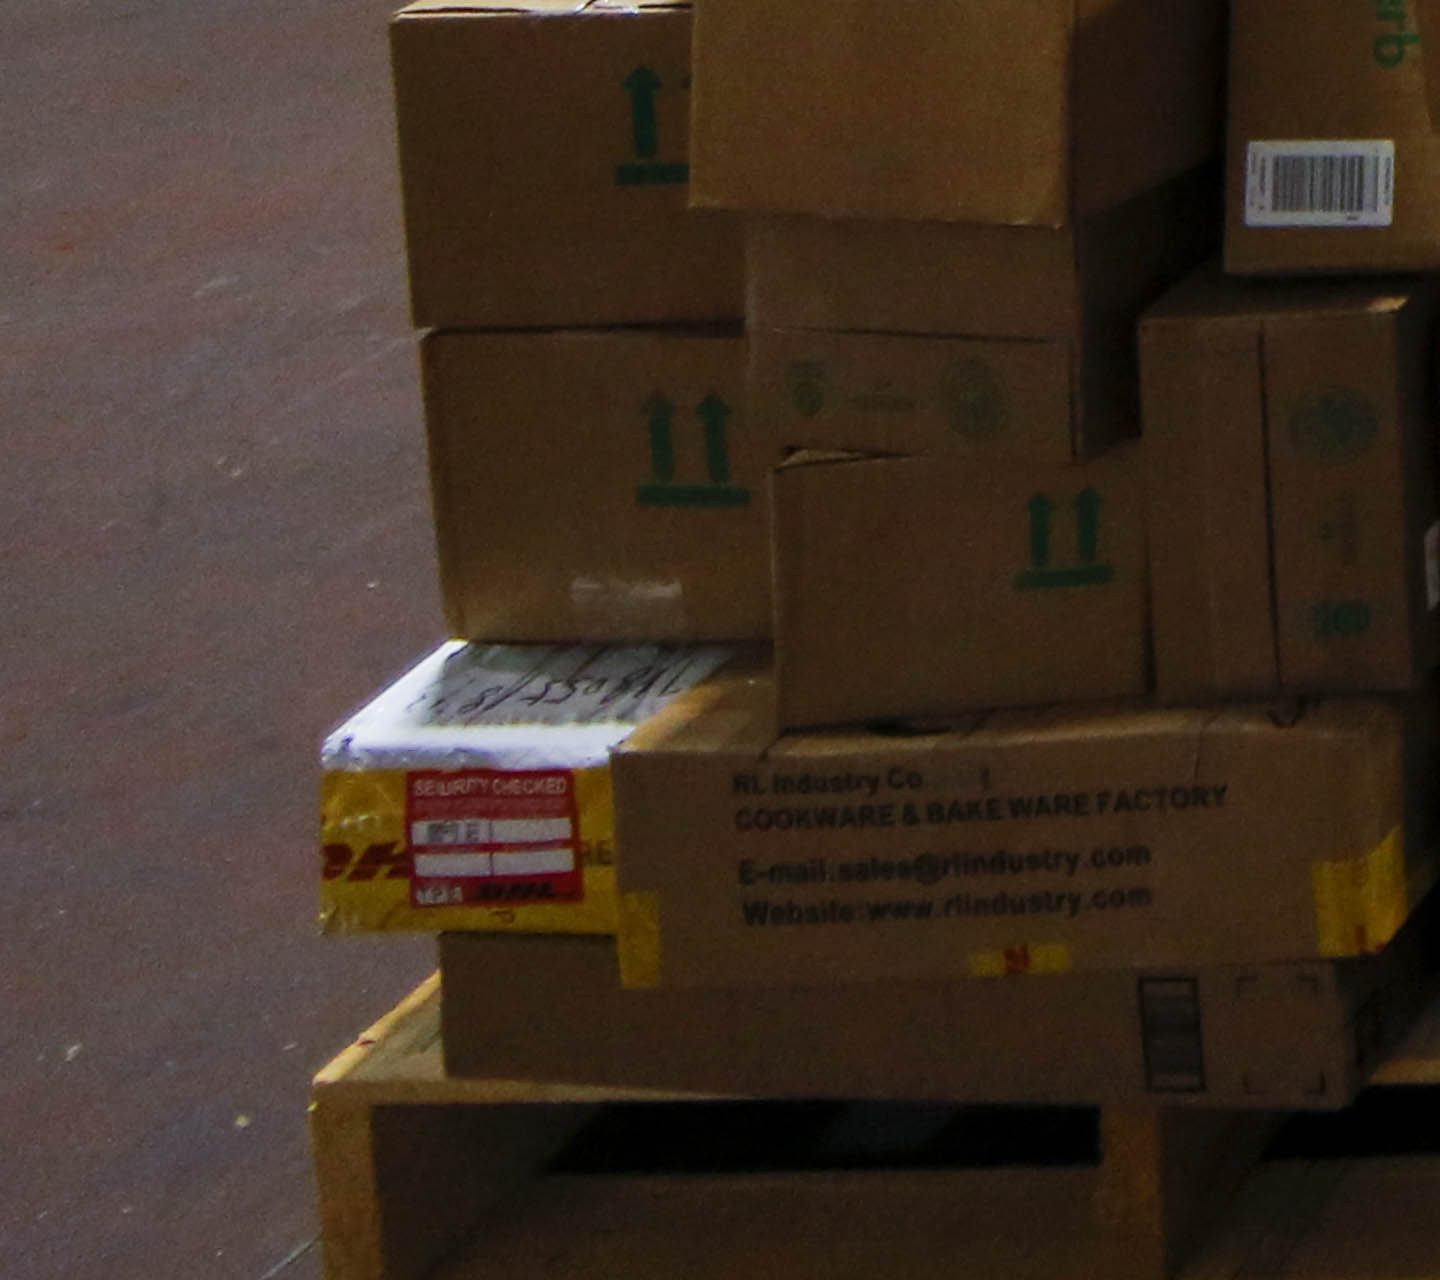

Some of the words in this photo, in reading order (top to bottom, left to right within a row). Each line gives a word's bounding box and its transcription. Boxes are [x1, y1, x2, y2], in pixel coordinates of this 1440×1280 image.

[491, 776, 567, 795] CHECKED
[772, 769, 881, 797] Industry
[734, 804, 898, 833] COOKWARE
[901, 805, 921, 828] &
[1096, 784, 1230, 815] FACTORY
